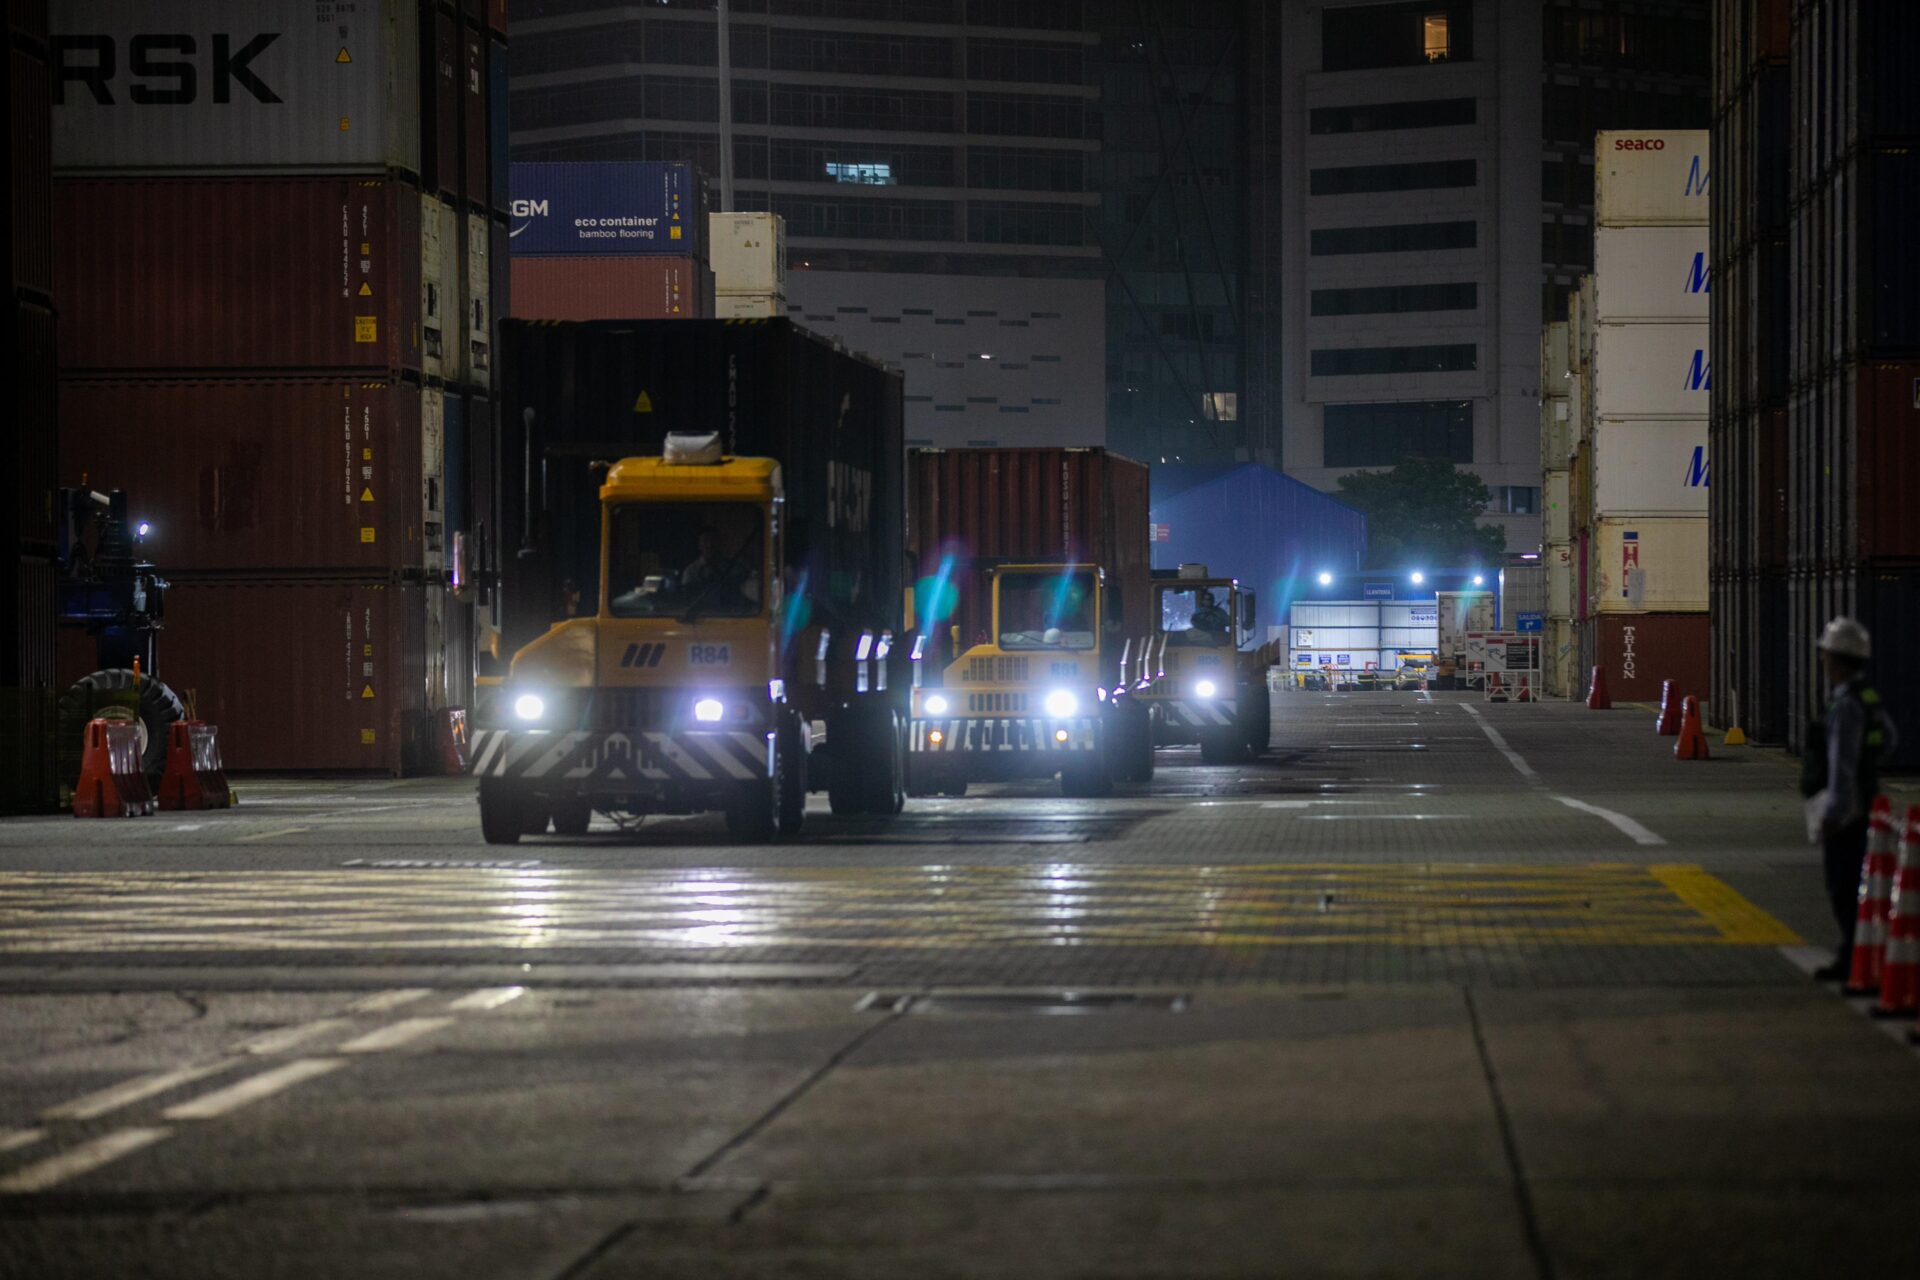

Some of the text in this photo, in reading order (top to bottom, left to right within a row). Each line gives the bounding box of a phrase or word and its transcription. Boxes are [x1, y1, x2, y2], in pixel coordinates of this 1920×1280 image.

[50, 33, 284, 104] RSK
[1615, 138, 1665, 151] seaco
[509, 199, 549, 217] GM
[574, 216, 658, 227] eco container
[579, 229, 654, 240] bamboo flooring
[691, 645, 729, 664] R84
[1623, 626, 1636, 679] TRITON
